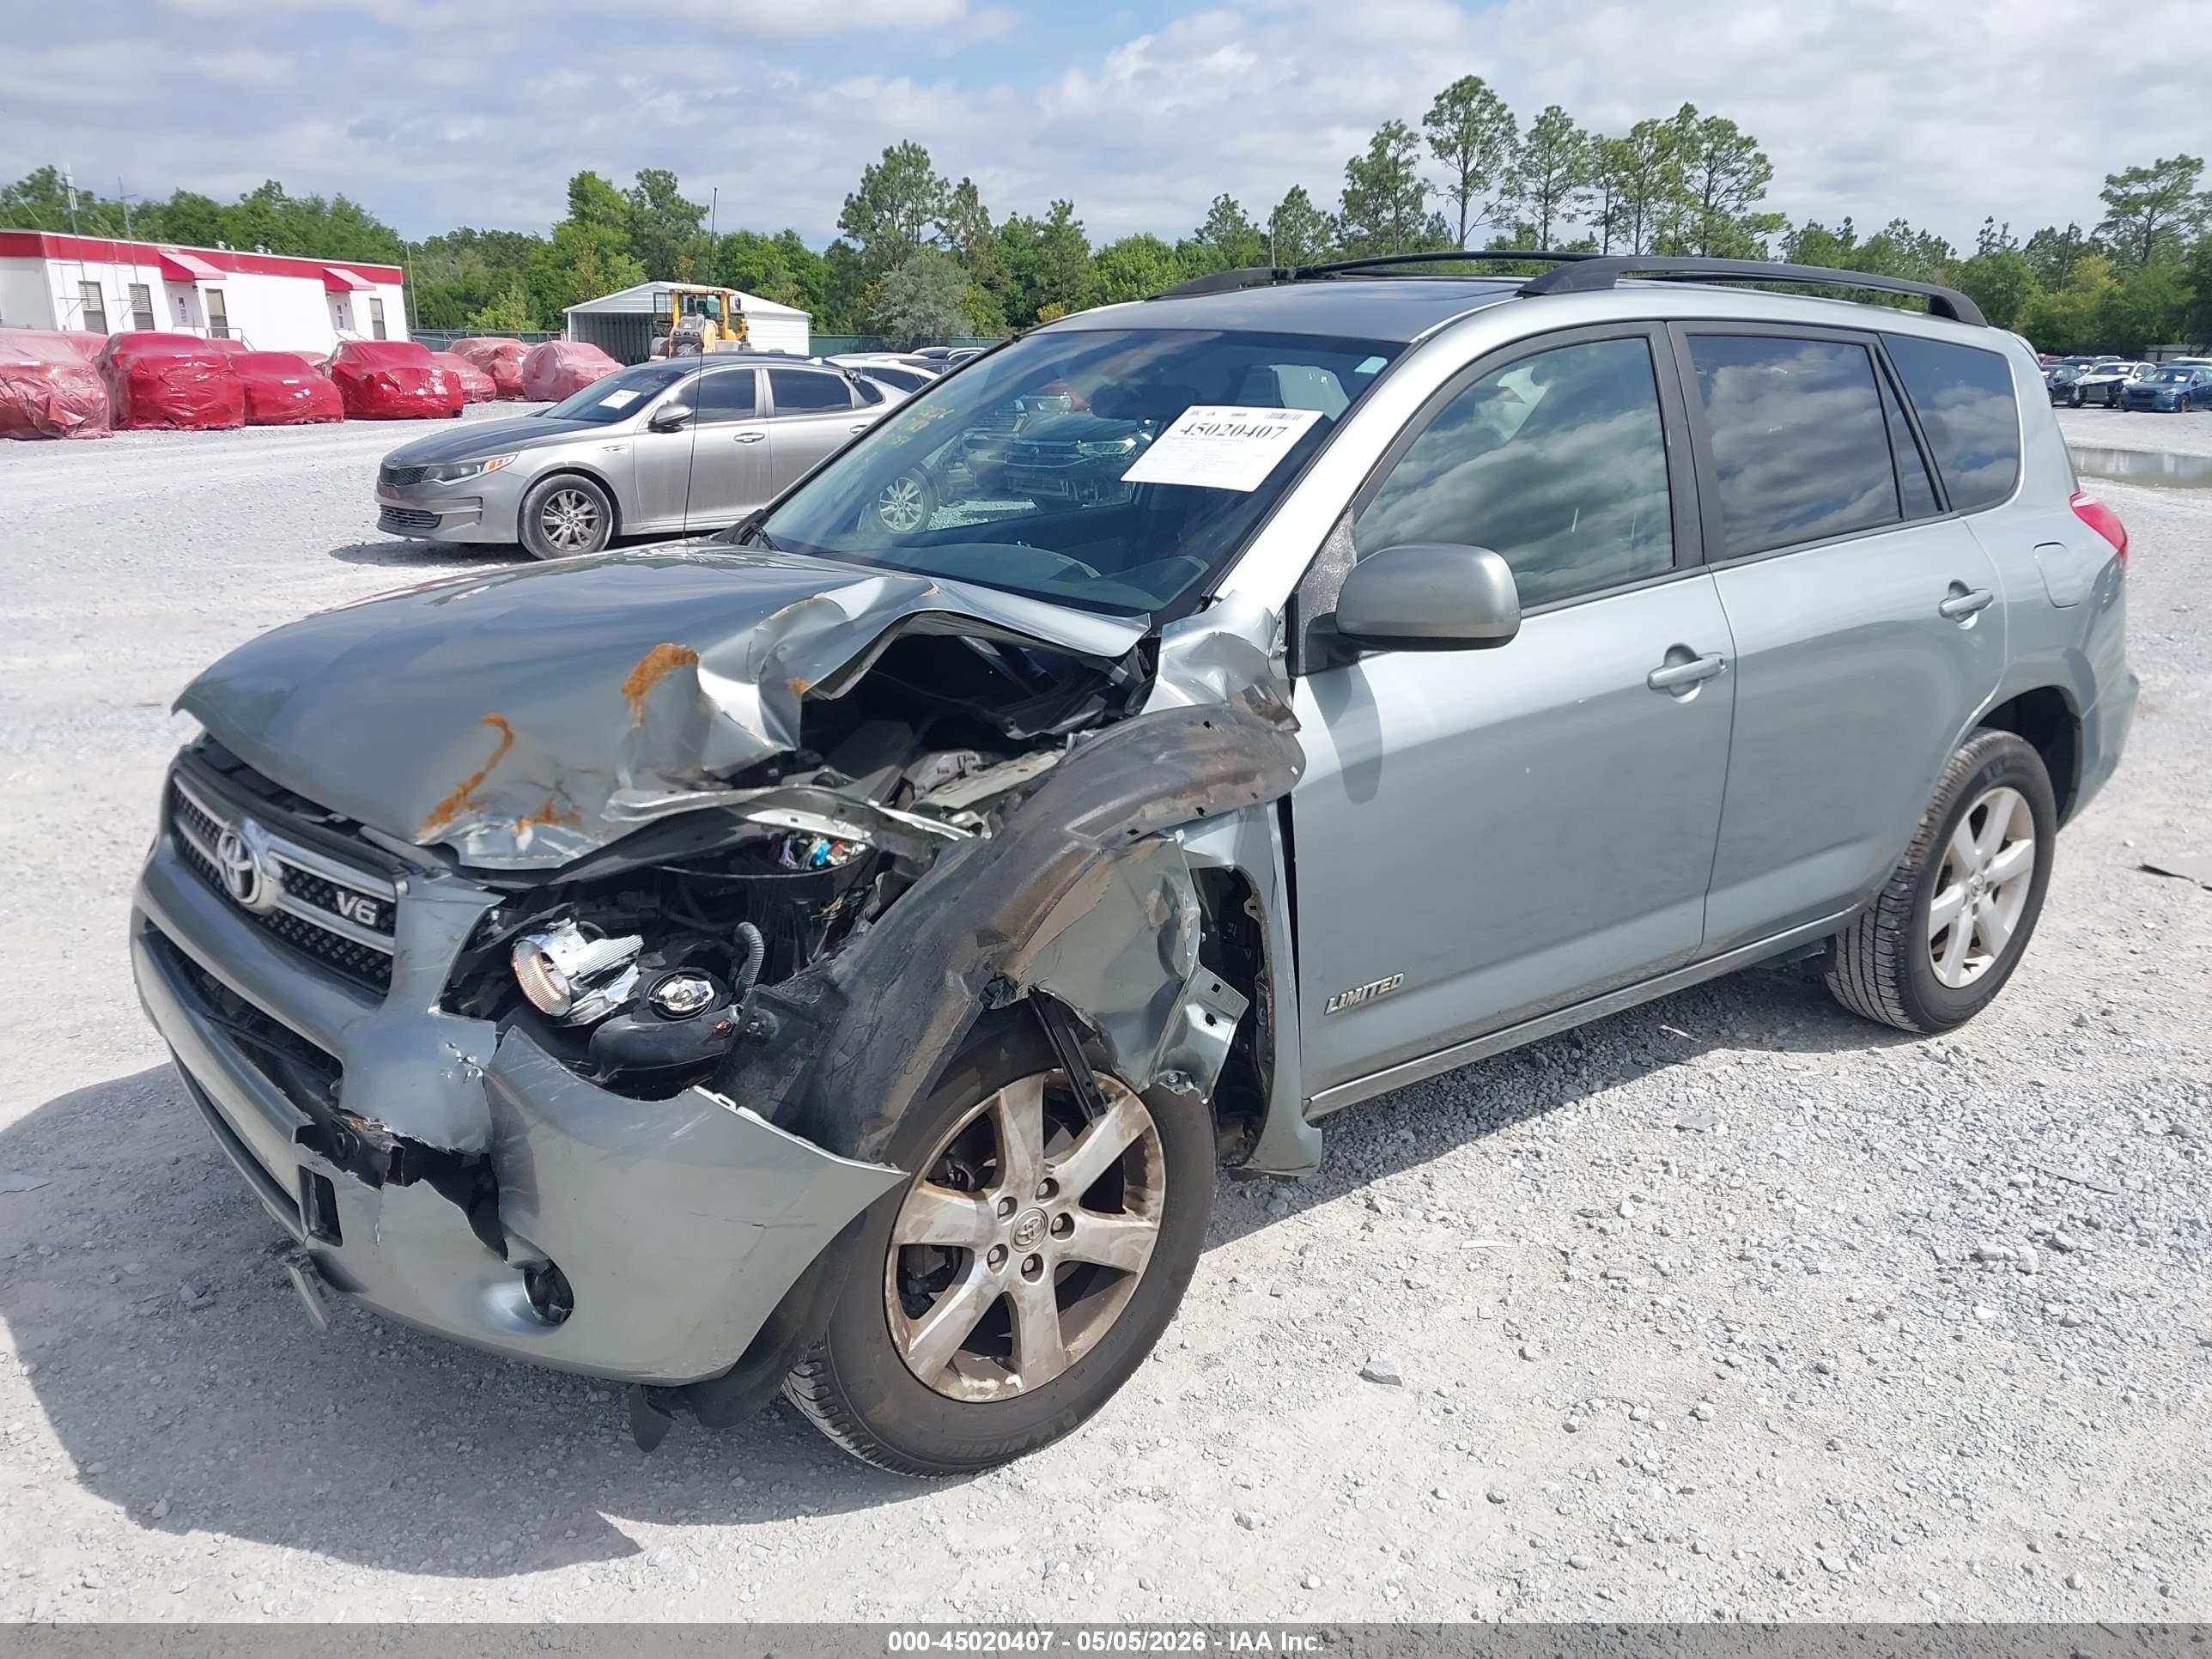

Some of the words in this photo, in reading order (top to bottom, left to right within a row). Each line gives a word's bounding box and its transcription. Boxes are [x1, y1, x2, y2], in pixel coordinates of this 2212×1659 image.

[1179, 422, 1290, 441] 45020407
[336, 890, 378, 926] V6
[1324, 972, 1406, 1015] LIMITED
